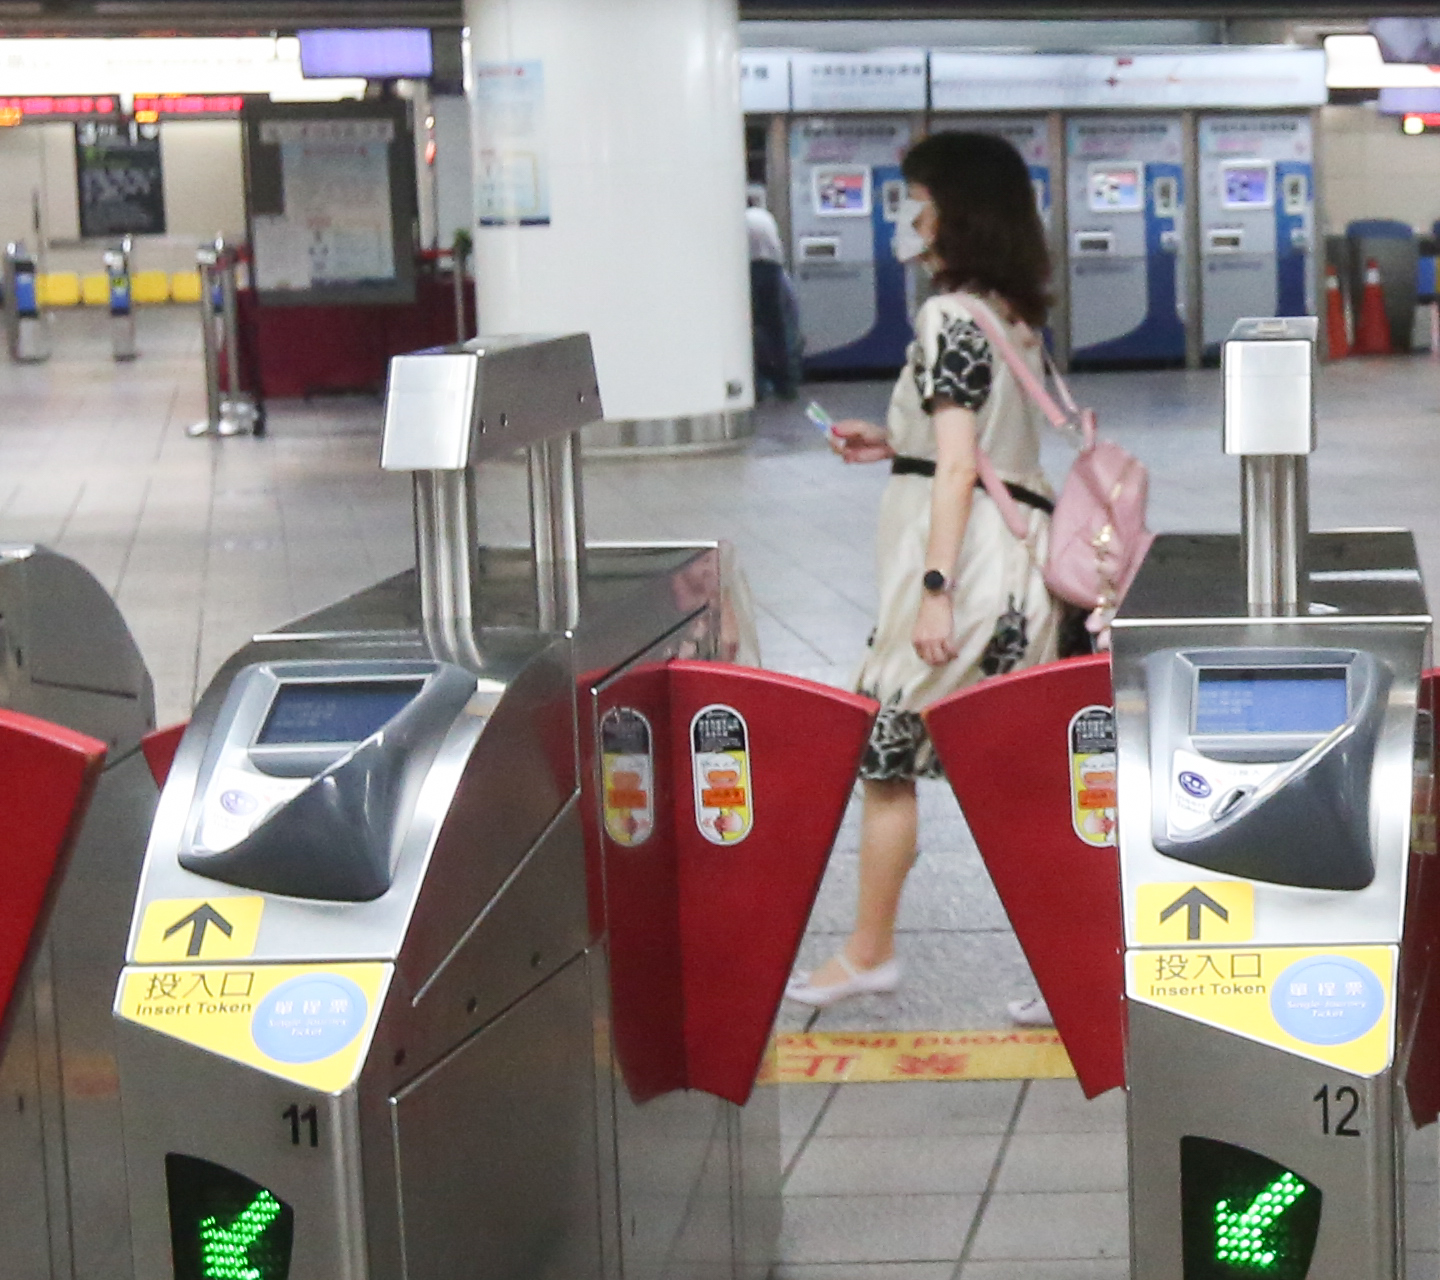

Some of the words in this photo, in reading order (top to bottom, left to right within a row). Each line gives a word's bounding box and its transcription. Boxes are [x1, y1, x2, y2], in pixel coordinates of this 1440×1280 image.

[1155, 953, 1261, 980] 投入口
[144, 972, 254, 1000] 投入口
[1150, 985, 1204, 996] Insert
[1213, 983, 1266, 995] Token
[136, 1003, 191, 1016] Insert
[198, 1002, 251, 1015] Token
[1313, 1084, 1360, 1137] 12
[282, 1104, 318, 1147] 11
